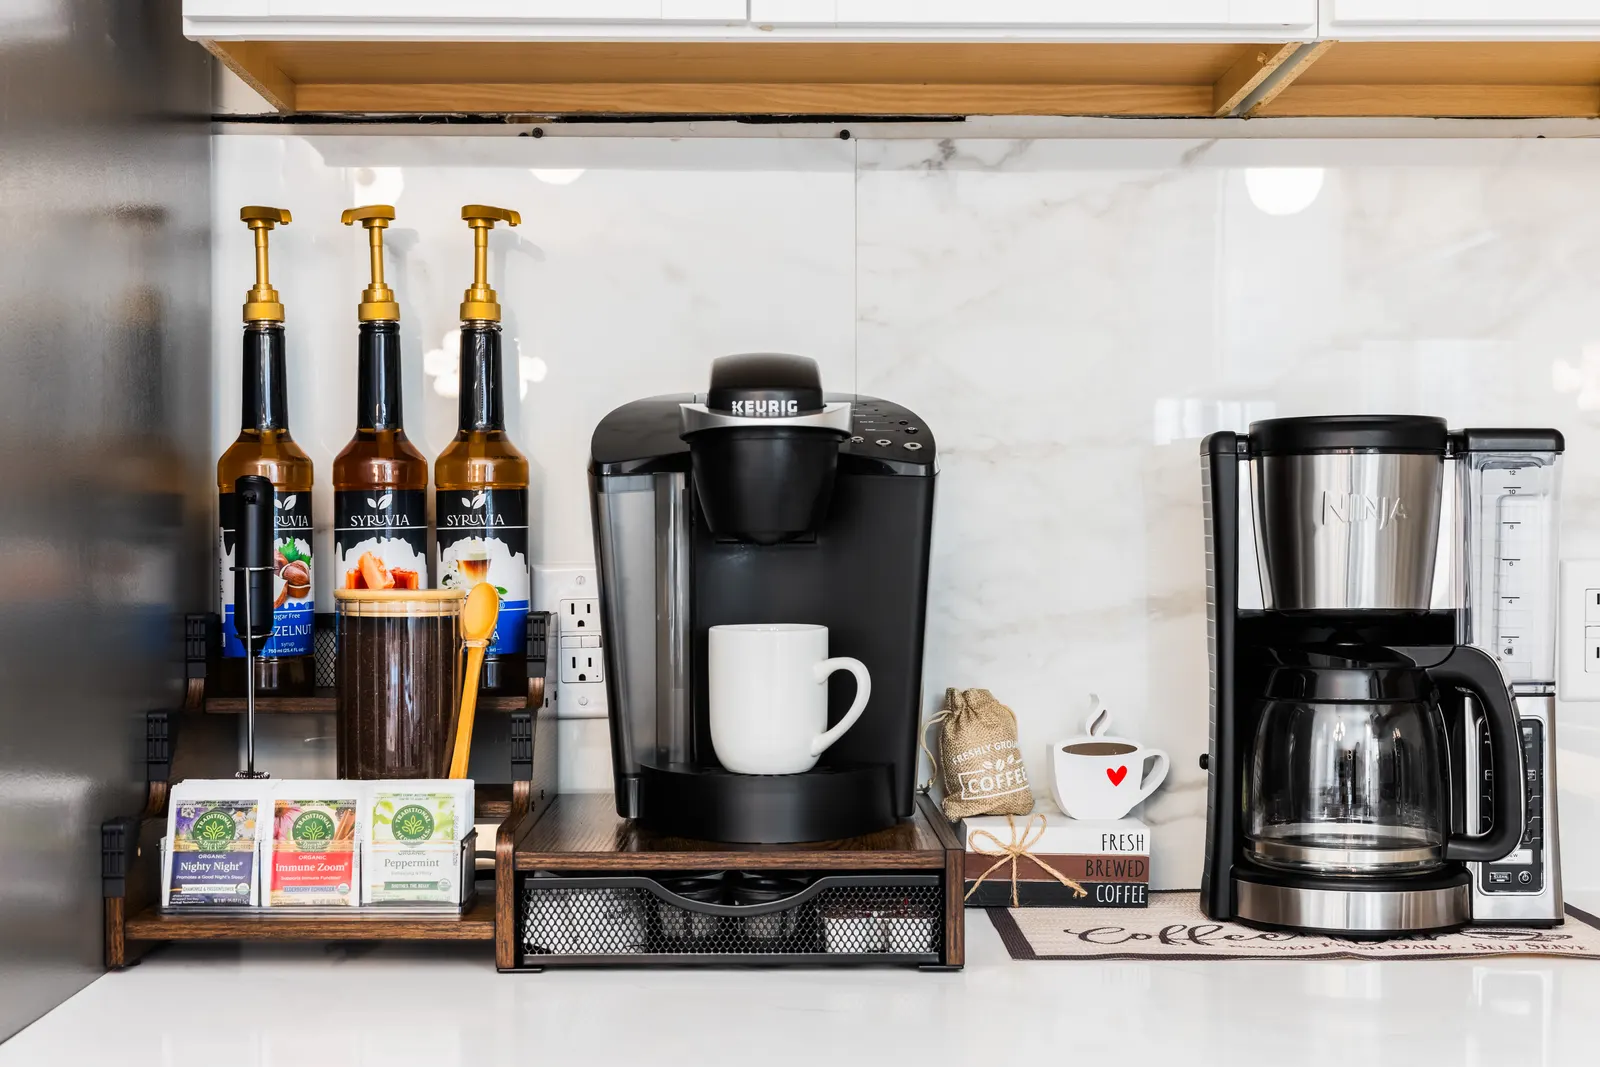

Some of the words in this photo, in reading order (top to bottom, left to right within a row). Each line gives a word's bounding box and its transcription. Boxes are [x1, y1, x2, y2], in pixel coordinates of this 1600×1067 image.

[732, 400, 798, 413] KEURIG
[1322, 491, 1408, 530] NINJA
[274, 515, 309, 527] RUVIA
[351, 514, 410, 527] SYRUVIA
[446, 514, 505, 527] SYRUVIA
[273, 624, 312, 637] ZELNUT
[952, 744, 991, 765] FRESHLY
[967, 766, 1028, 793] COFFEE
[197, 813, 233, 829] TRADITIONAL
[295, 813, 332, 829] TRADITIONAL
[395, 807, 431, 824] TRADITIONAL
[1102, 833, 1144, 851] FRESH
[180, 862, 213, 873] Nighty
[275, 863, 316, 872] Immune
[384, 858, 440, 869] Peppermint
[1086, 859, 1145, 878] BREWED
[1097, 884, 1145, 904] COFFEE
